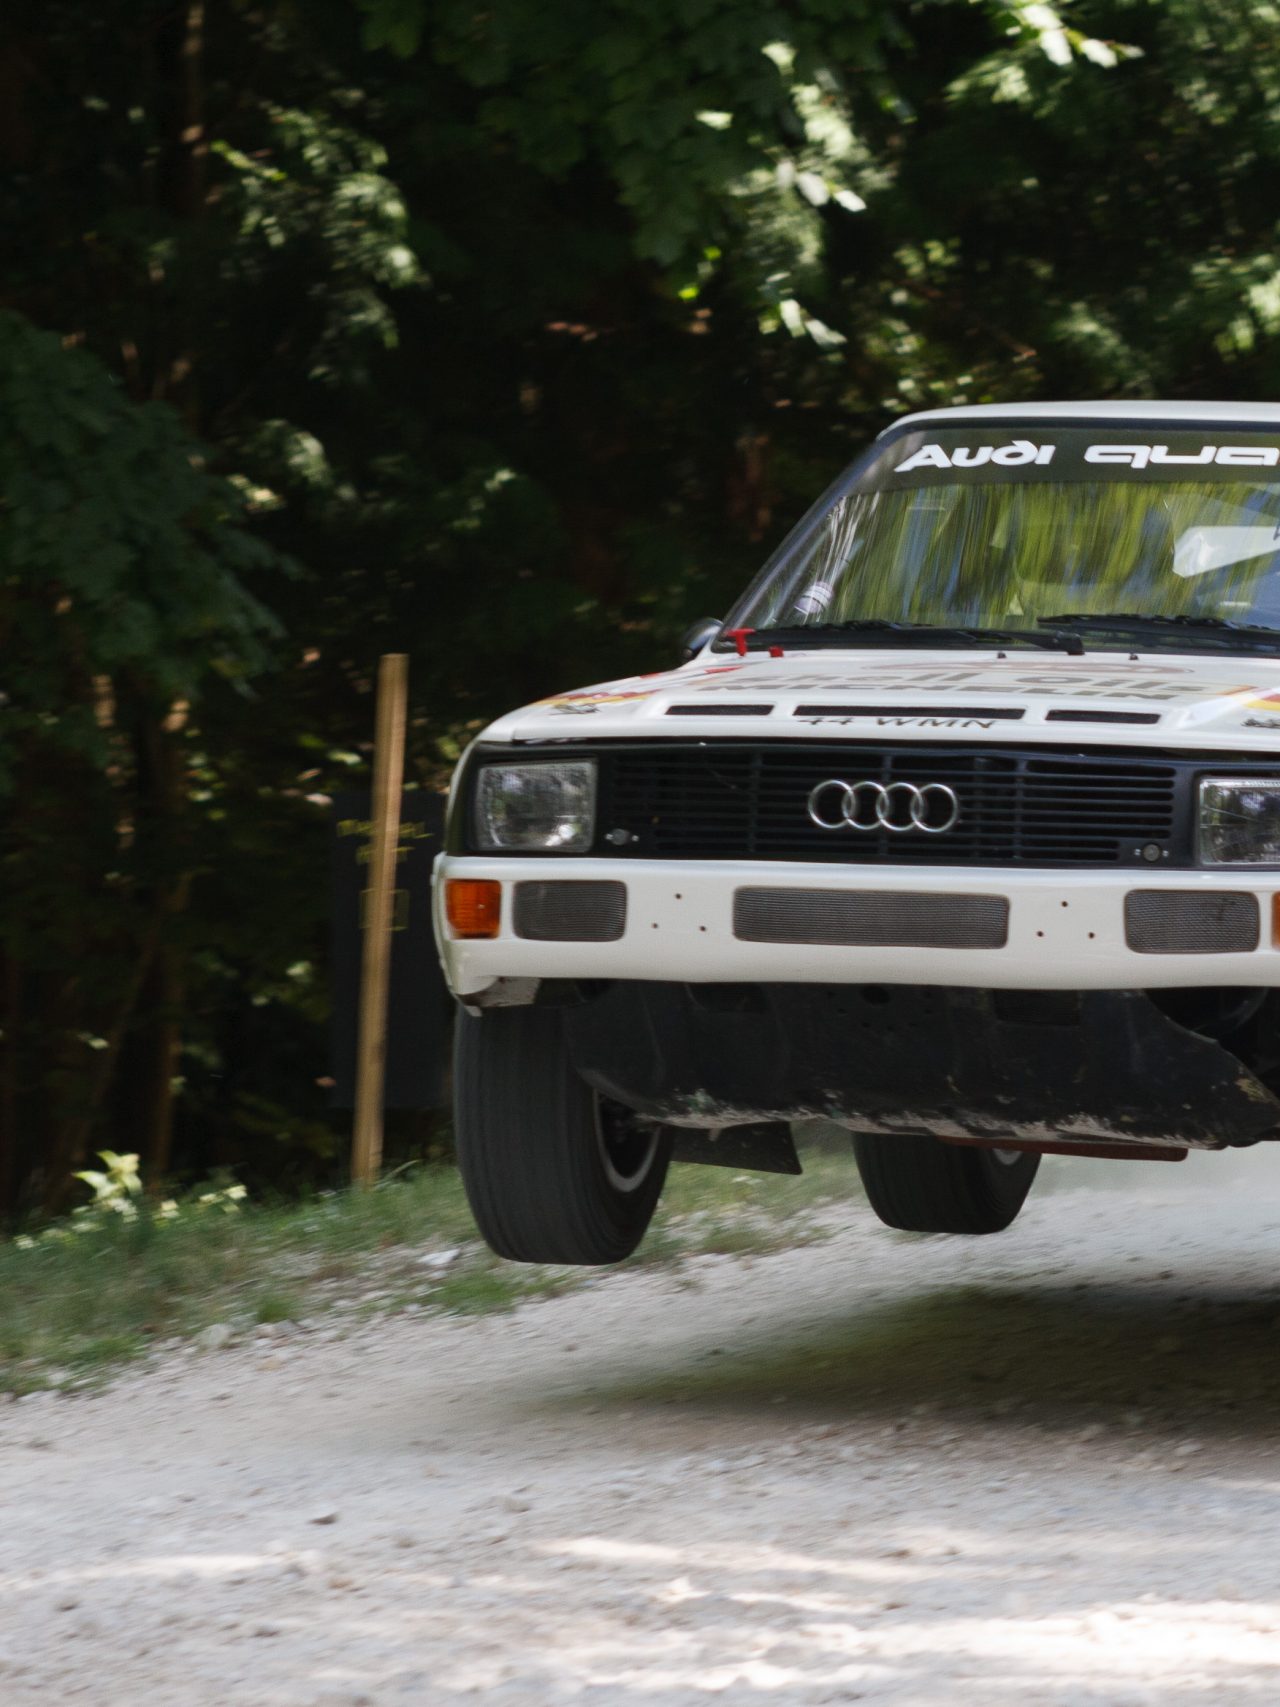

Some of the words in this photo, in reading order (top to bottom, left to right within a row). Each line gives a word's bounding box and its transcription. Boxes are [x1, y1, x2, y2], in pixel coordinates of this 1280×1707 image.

[895, 440, 1057, 473] Audi
[697, 684, 1179, 700] MICHELIN
[876, 717, 997, 729] WMN
